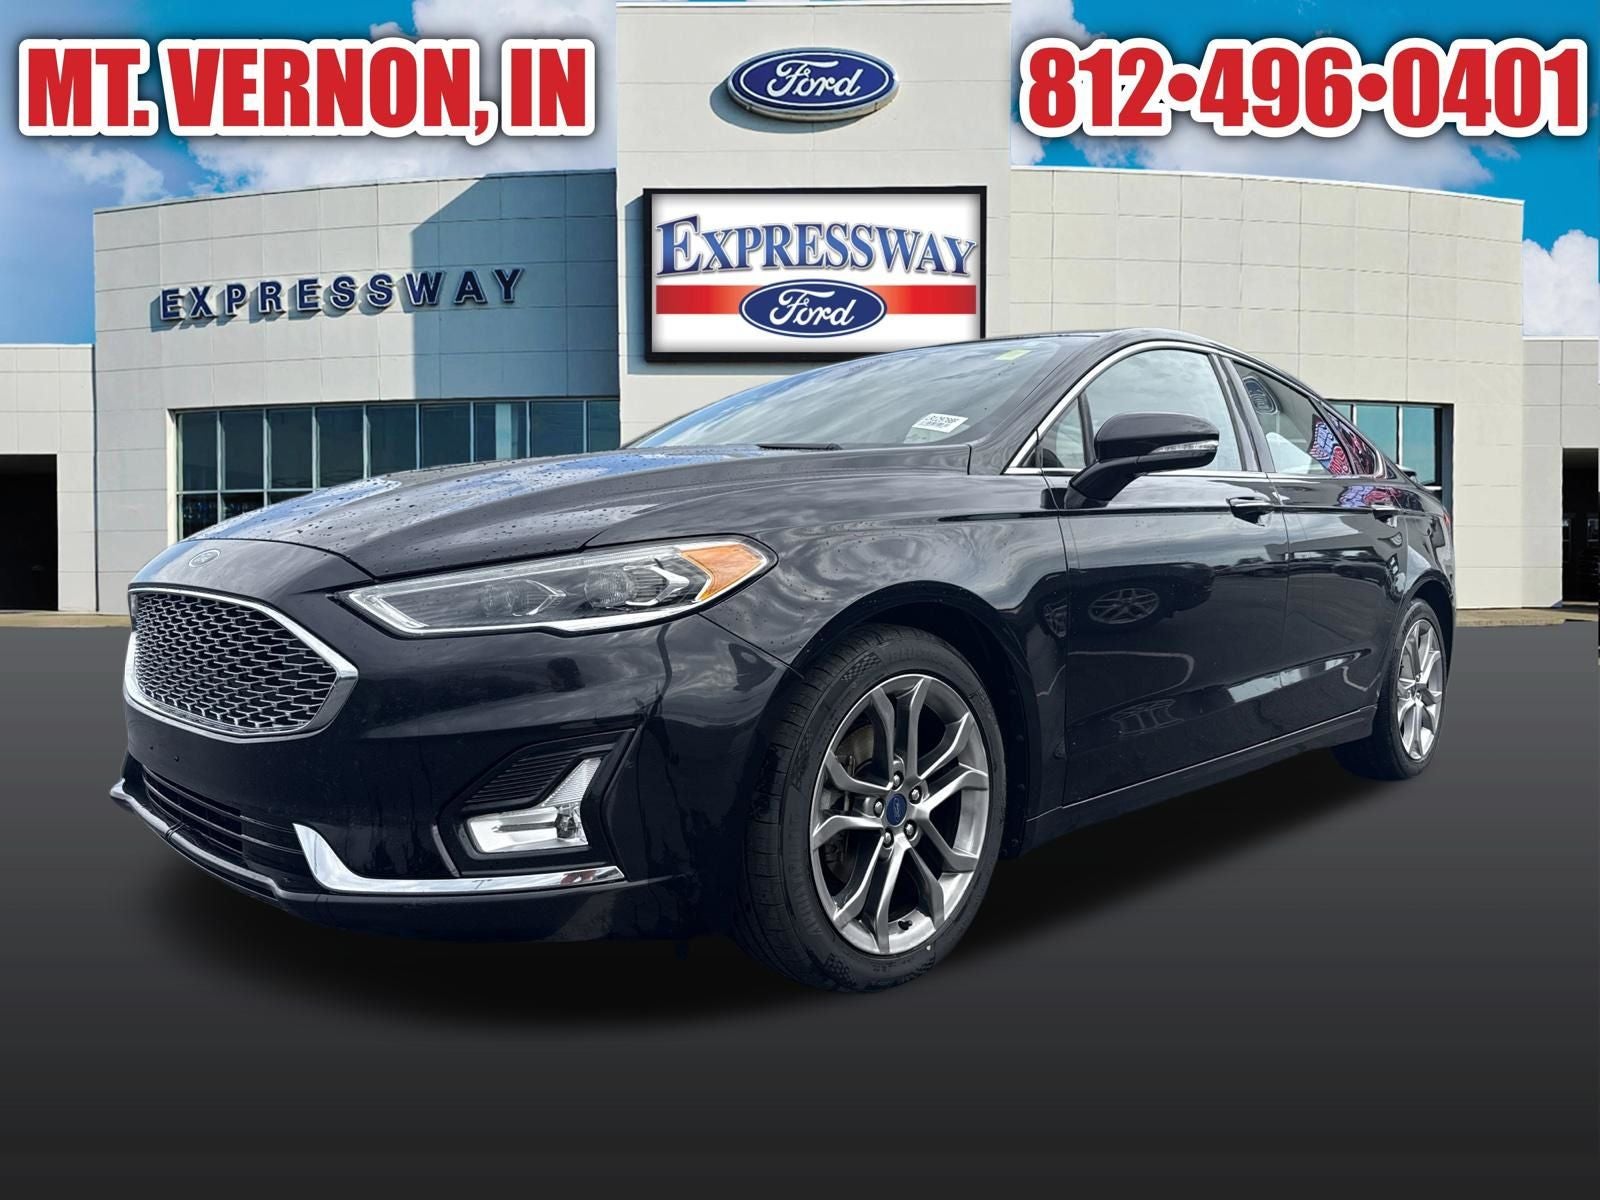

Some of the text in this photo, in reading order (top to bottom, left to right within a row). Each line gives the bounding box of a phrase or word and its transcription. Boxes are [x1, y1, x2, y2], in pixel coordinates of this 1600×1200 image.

[766, 59, 864, 97] Ford
[655, 214, 977, 278] EXPRESSWAY
[160, 267, 525, 320] EXPRESSWAY
[769, 288, 857, 326] Ford
